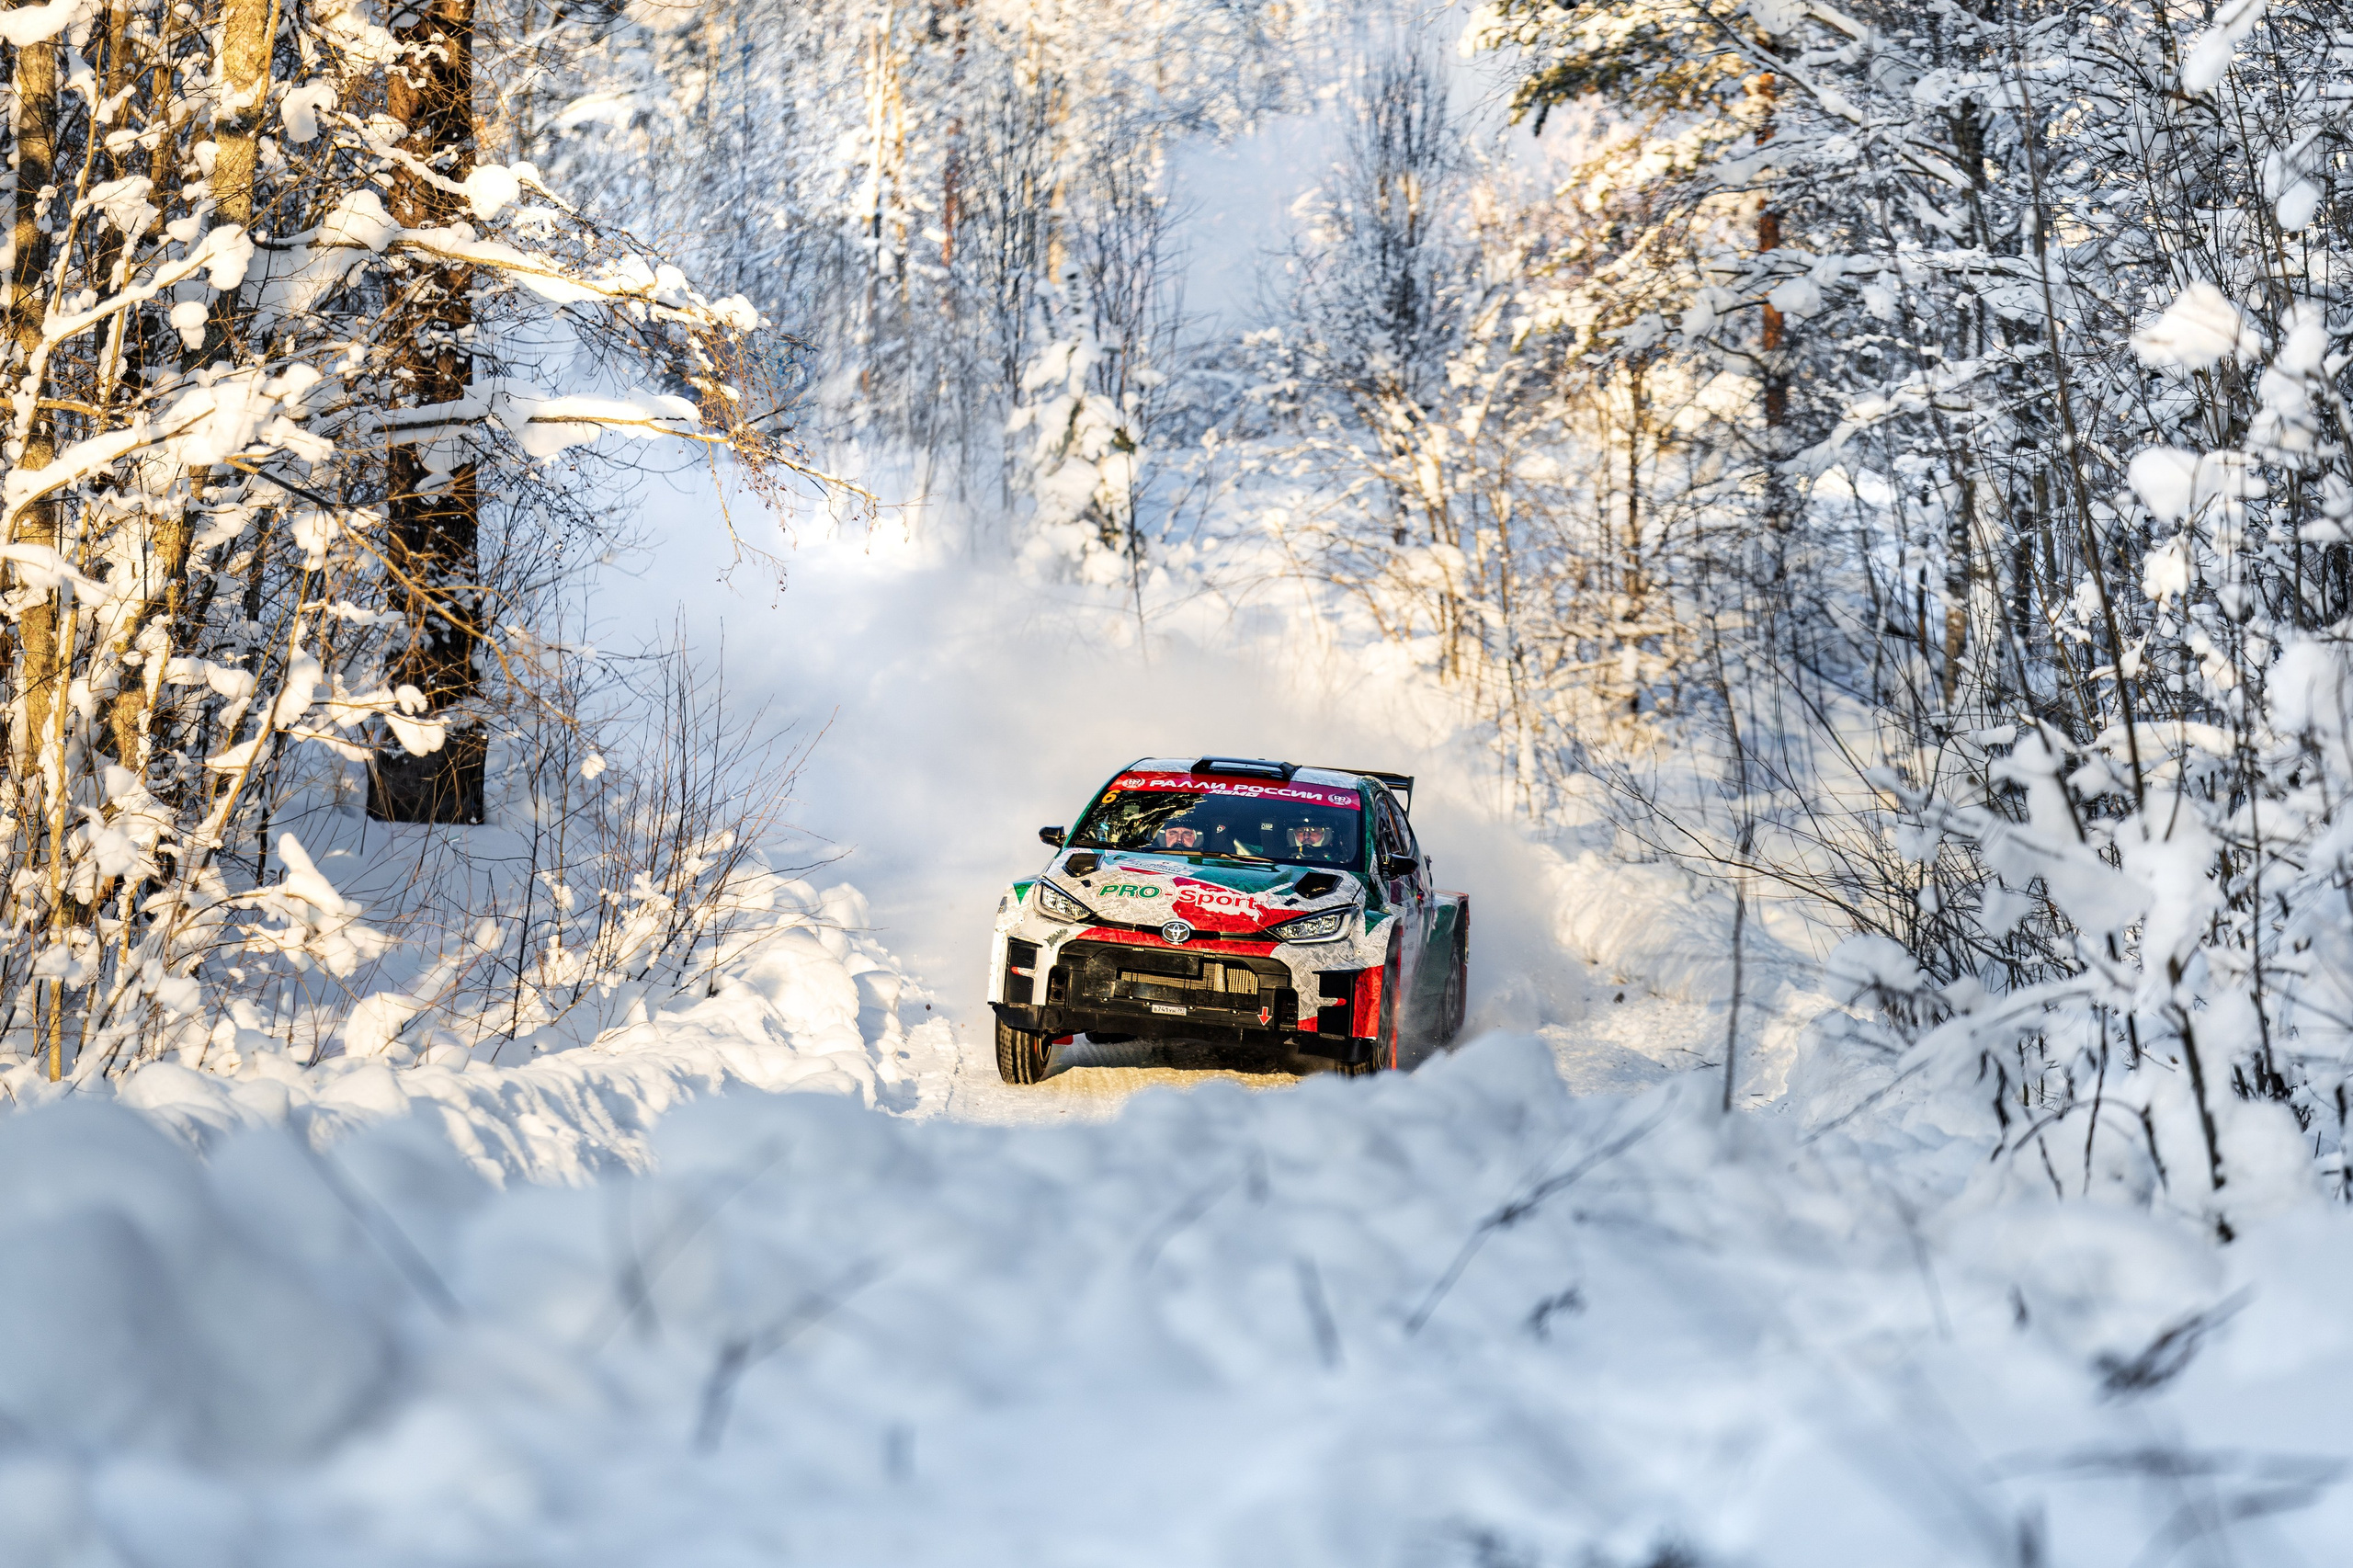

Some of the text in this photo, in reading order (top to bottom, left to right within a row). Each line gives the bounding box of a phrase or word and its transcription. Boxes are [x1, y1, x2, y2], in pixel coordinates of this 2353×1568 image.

[1101, 790, 1121, 804] 6
[1149, 779, 1226, 790] РАЛЛИ
[1233, 785, 1322, 801] РОССИИ
[1098, 884, 1161, 899] PRO
[1177, 889, 1257, 910] Sport
